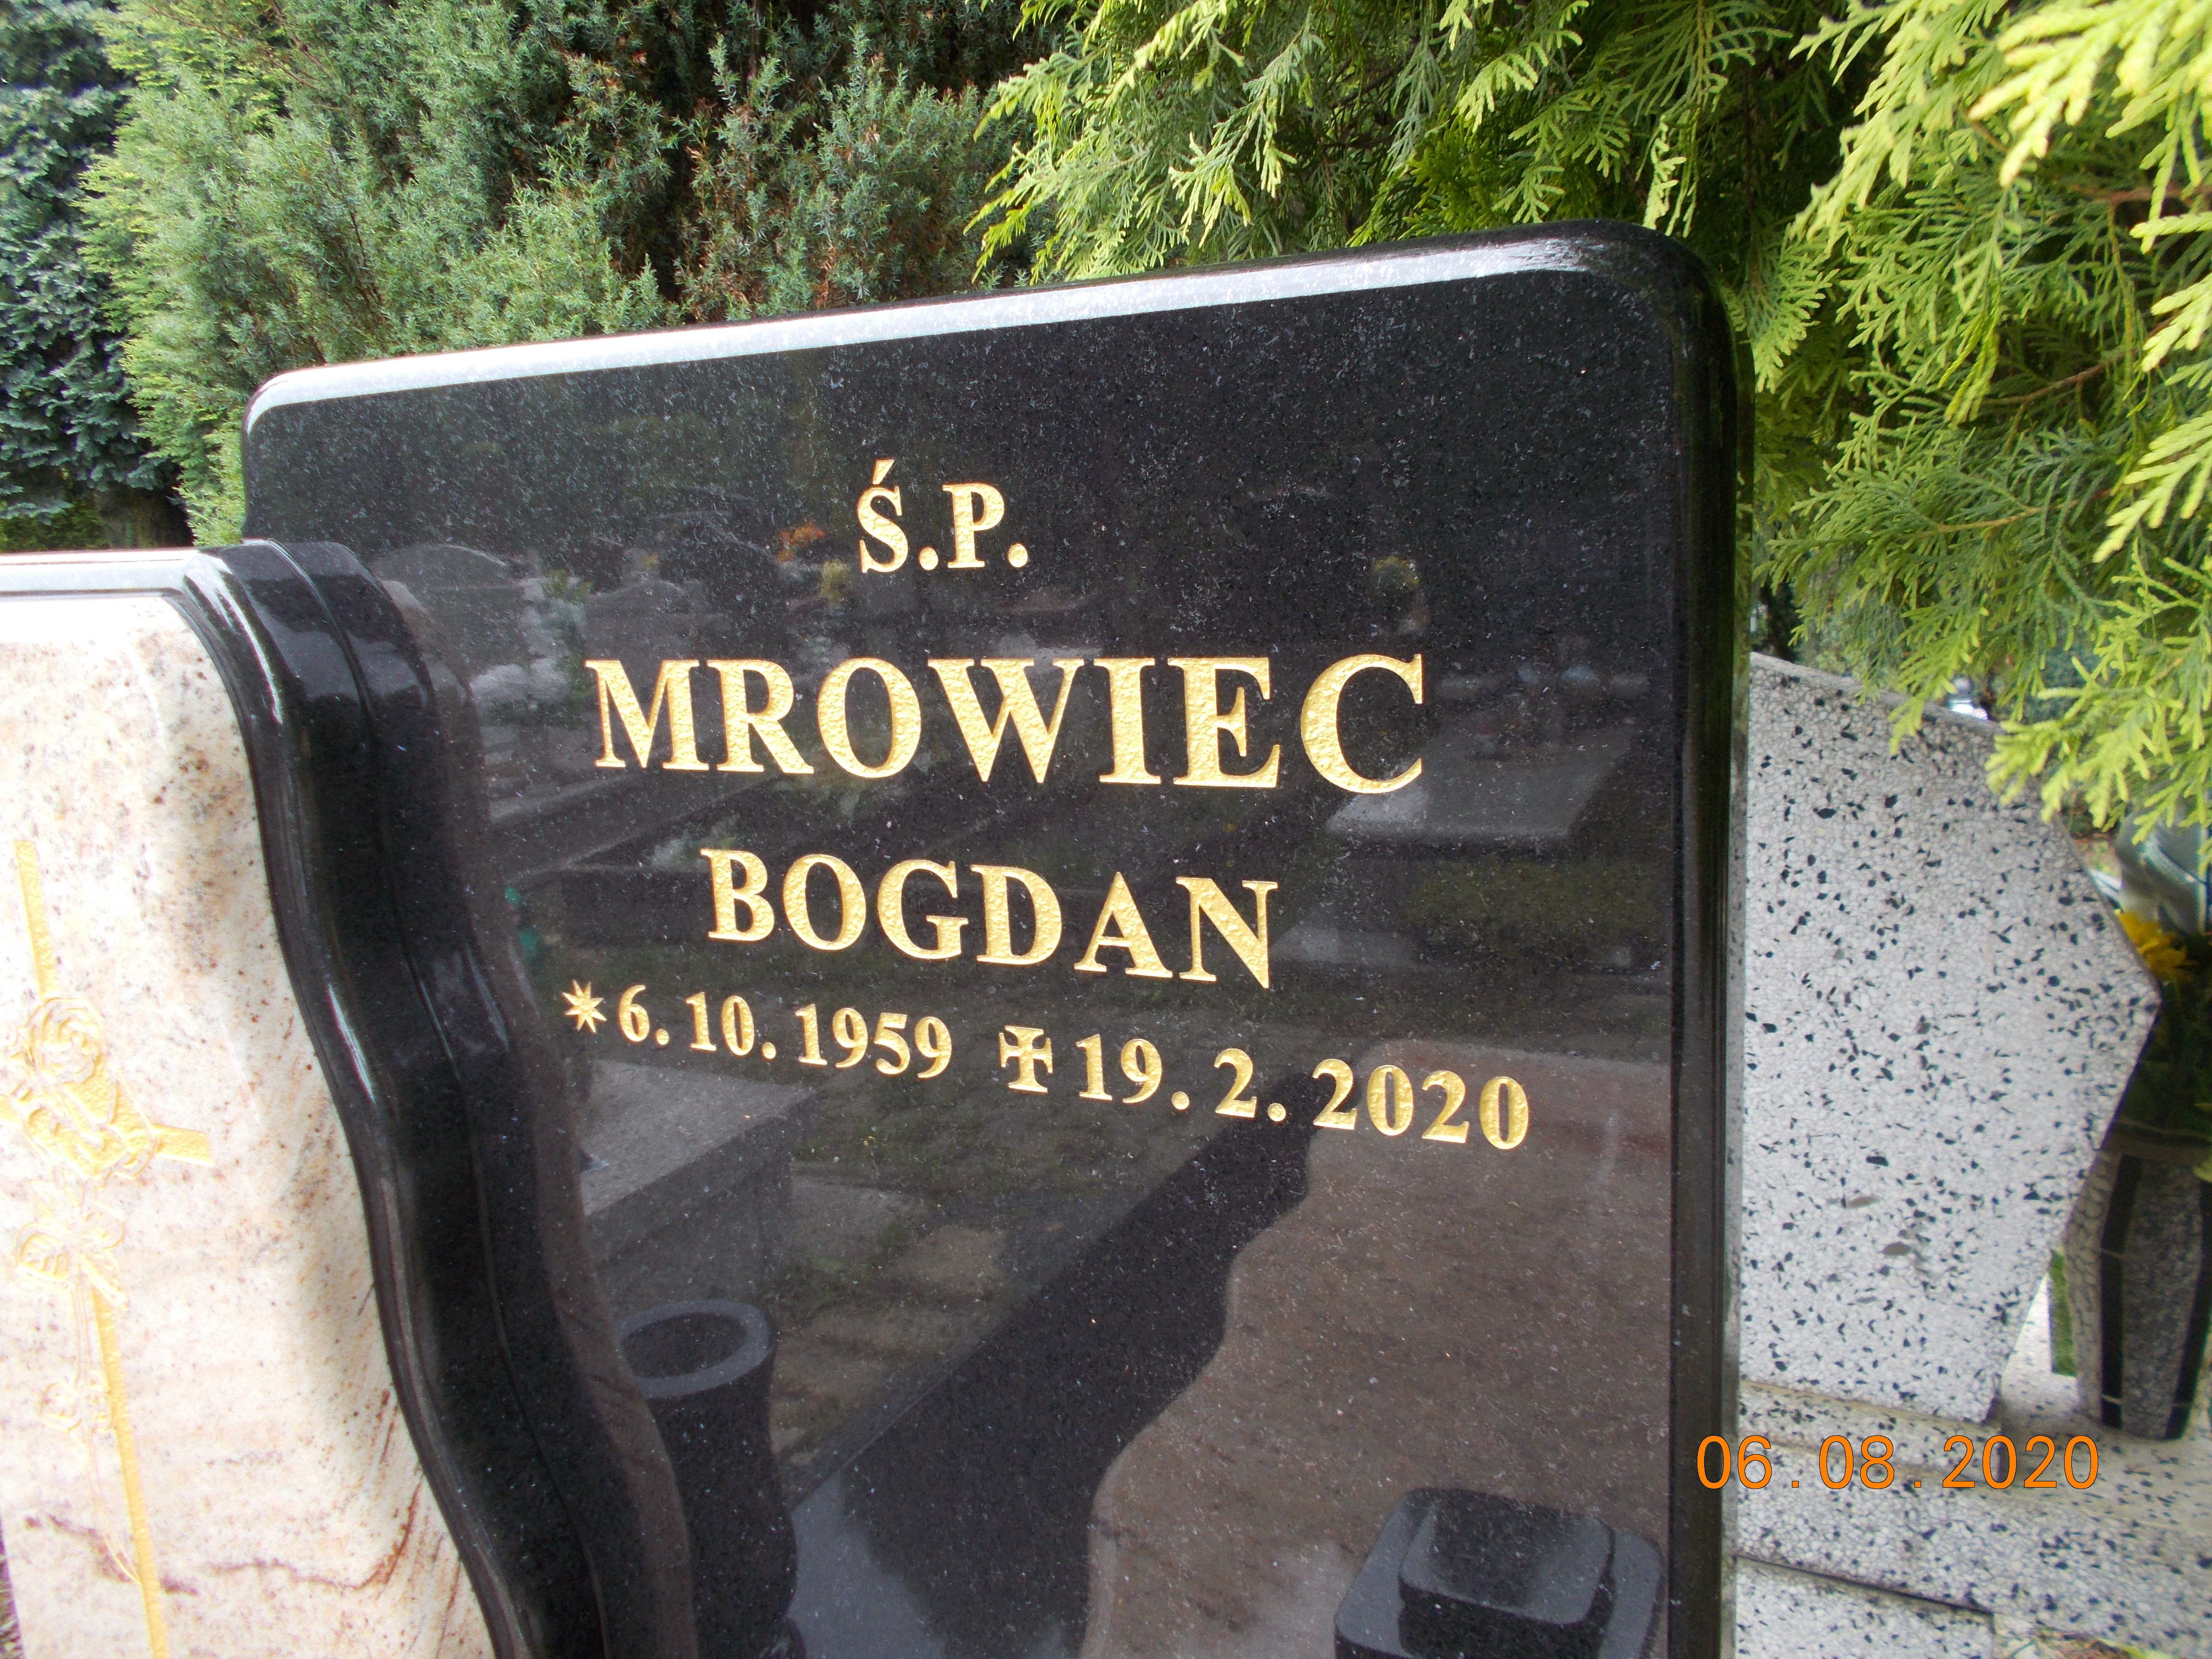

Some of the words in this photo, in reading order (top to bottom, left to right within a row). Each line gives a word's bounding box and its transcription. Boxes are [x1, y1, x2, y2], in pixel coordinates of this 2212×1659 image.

[855, 457, 1031, 579] Ś.P.
[583, 648, 1424, 798] MROWIEC
[698, 846, 1279, 990] BOGDAN
